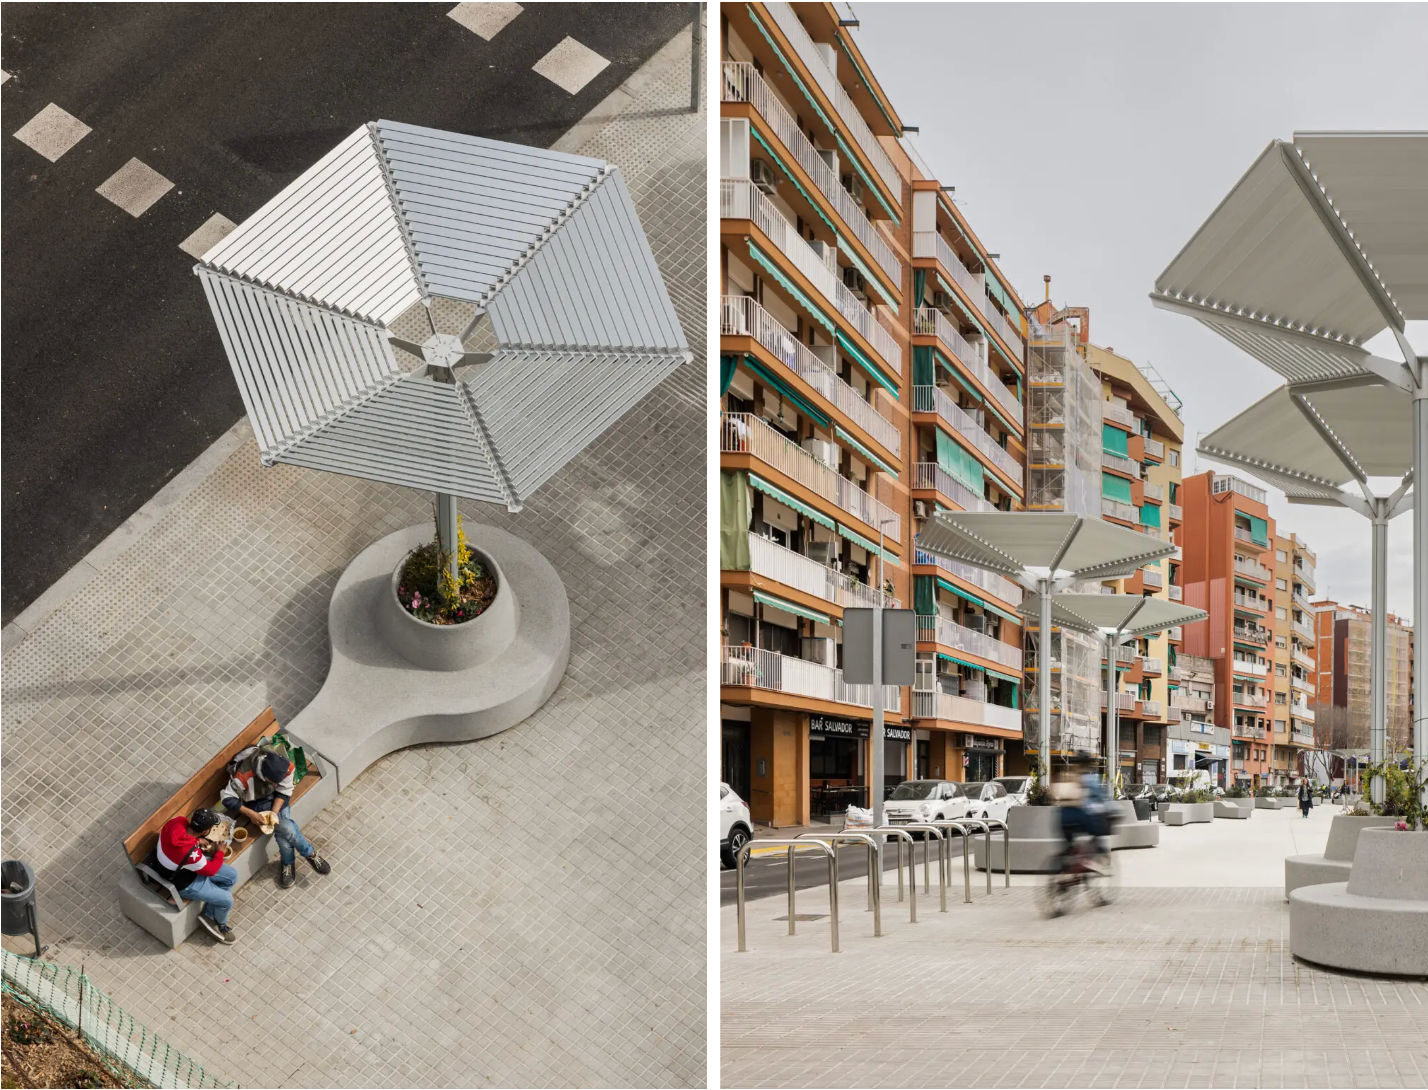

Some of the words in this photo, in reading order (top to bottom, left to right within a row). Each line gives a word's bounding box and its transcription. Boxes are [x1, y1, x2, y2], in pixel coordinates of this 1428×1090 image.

[810, 719, 823, 731] BAR
[824, 720, 853, 734] SALVADOR
[886, 728, 911, 740] SALVADOR
